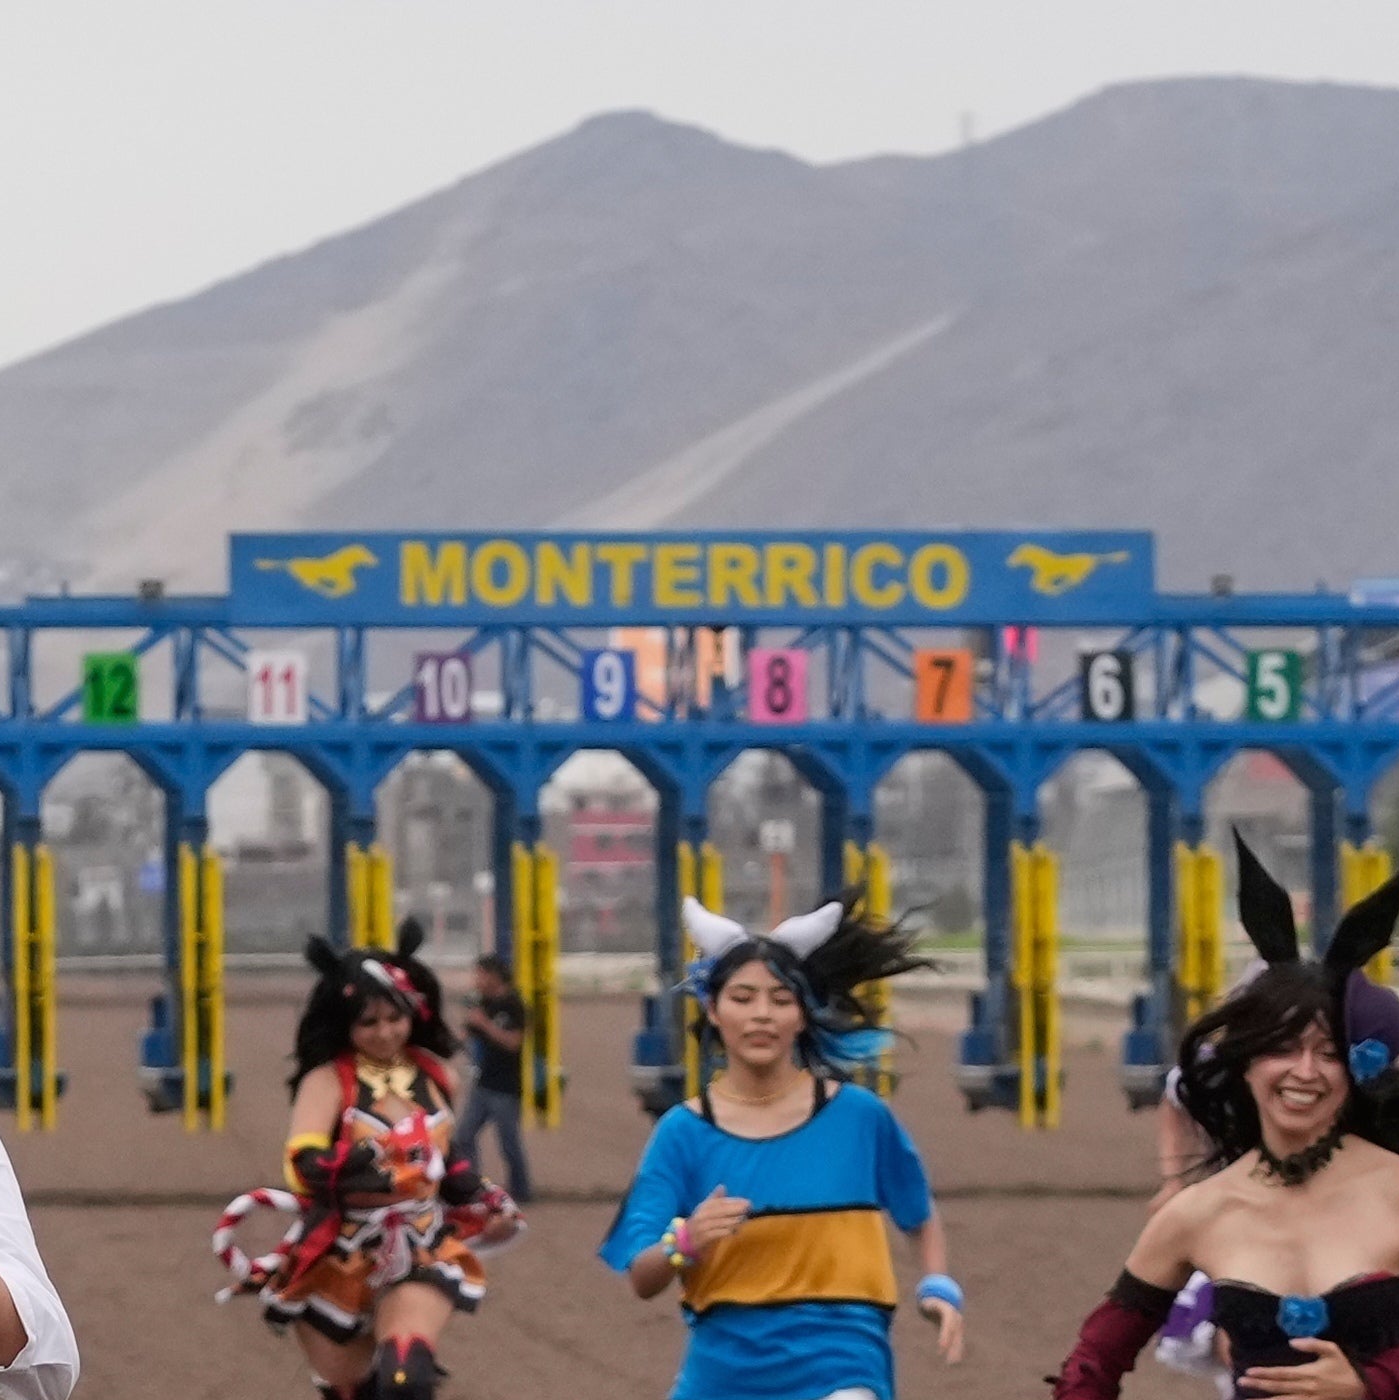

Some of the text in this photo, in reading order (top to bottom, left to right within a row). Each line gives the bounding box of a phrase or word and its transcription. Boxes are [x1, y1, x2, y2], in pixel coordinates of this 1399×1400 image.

[400, 542, 970, 608] MONTERRICO
[88, 663, 136, 717] 12
[256, 664, 297, 716] 11
[417, 657, 469, 720] 10
[593, 653, 626, 718] 9
[765, 657, 792, 714] 8
[930, 657, 957, 714] 7
[1087, 652, 1126, 720] 6
[1255, 652, 1292, 720] 5
